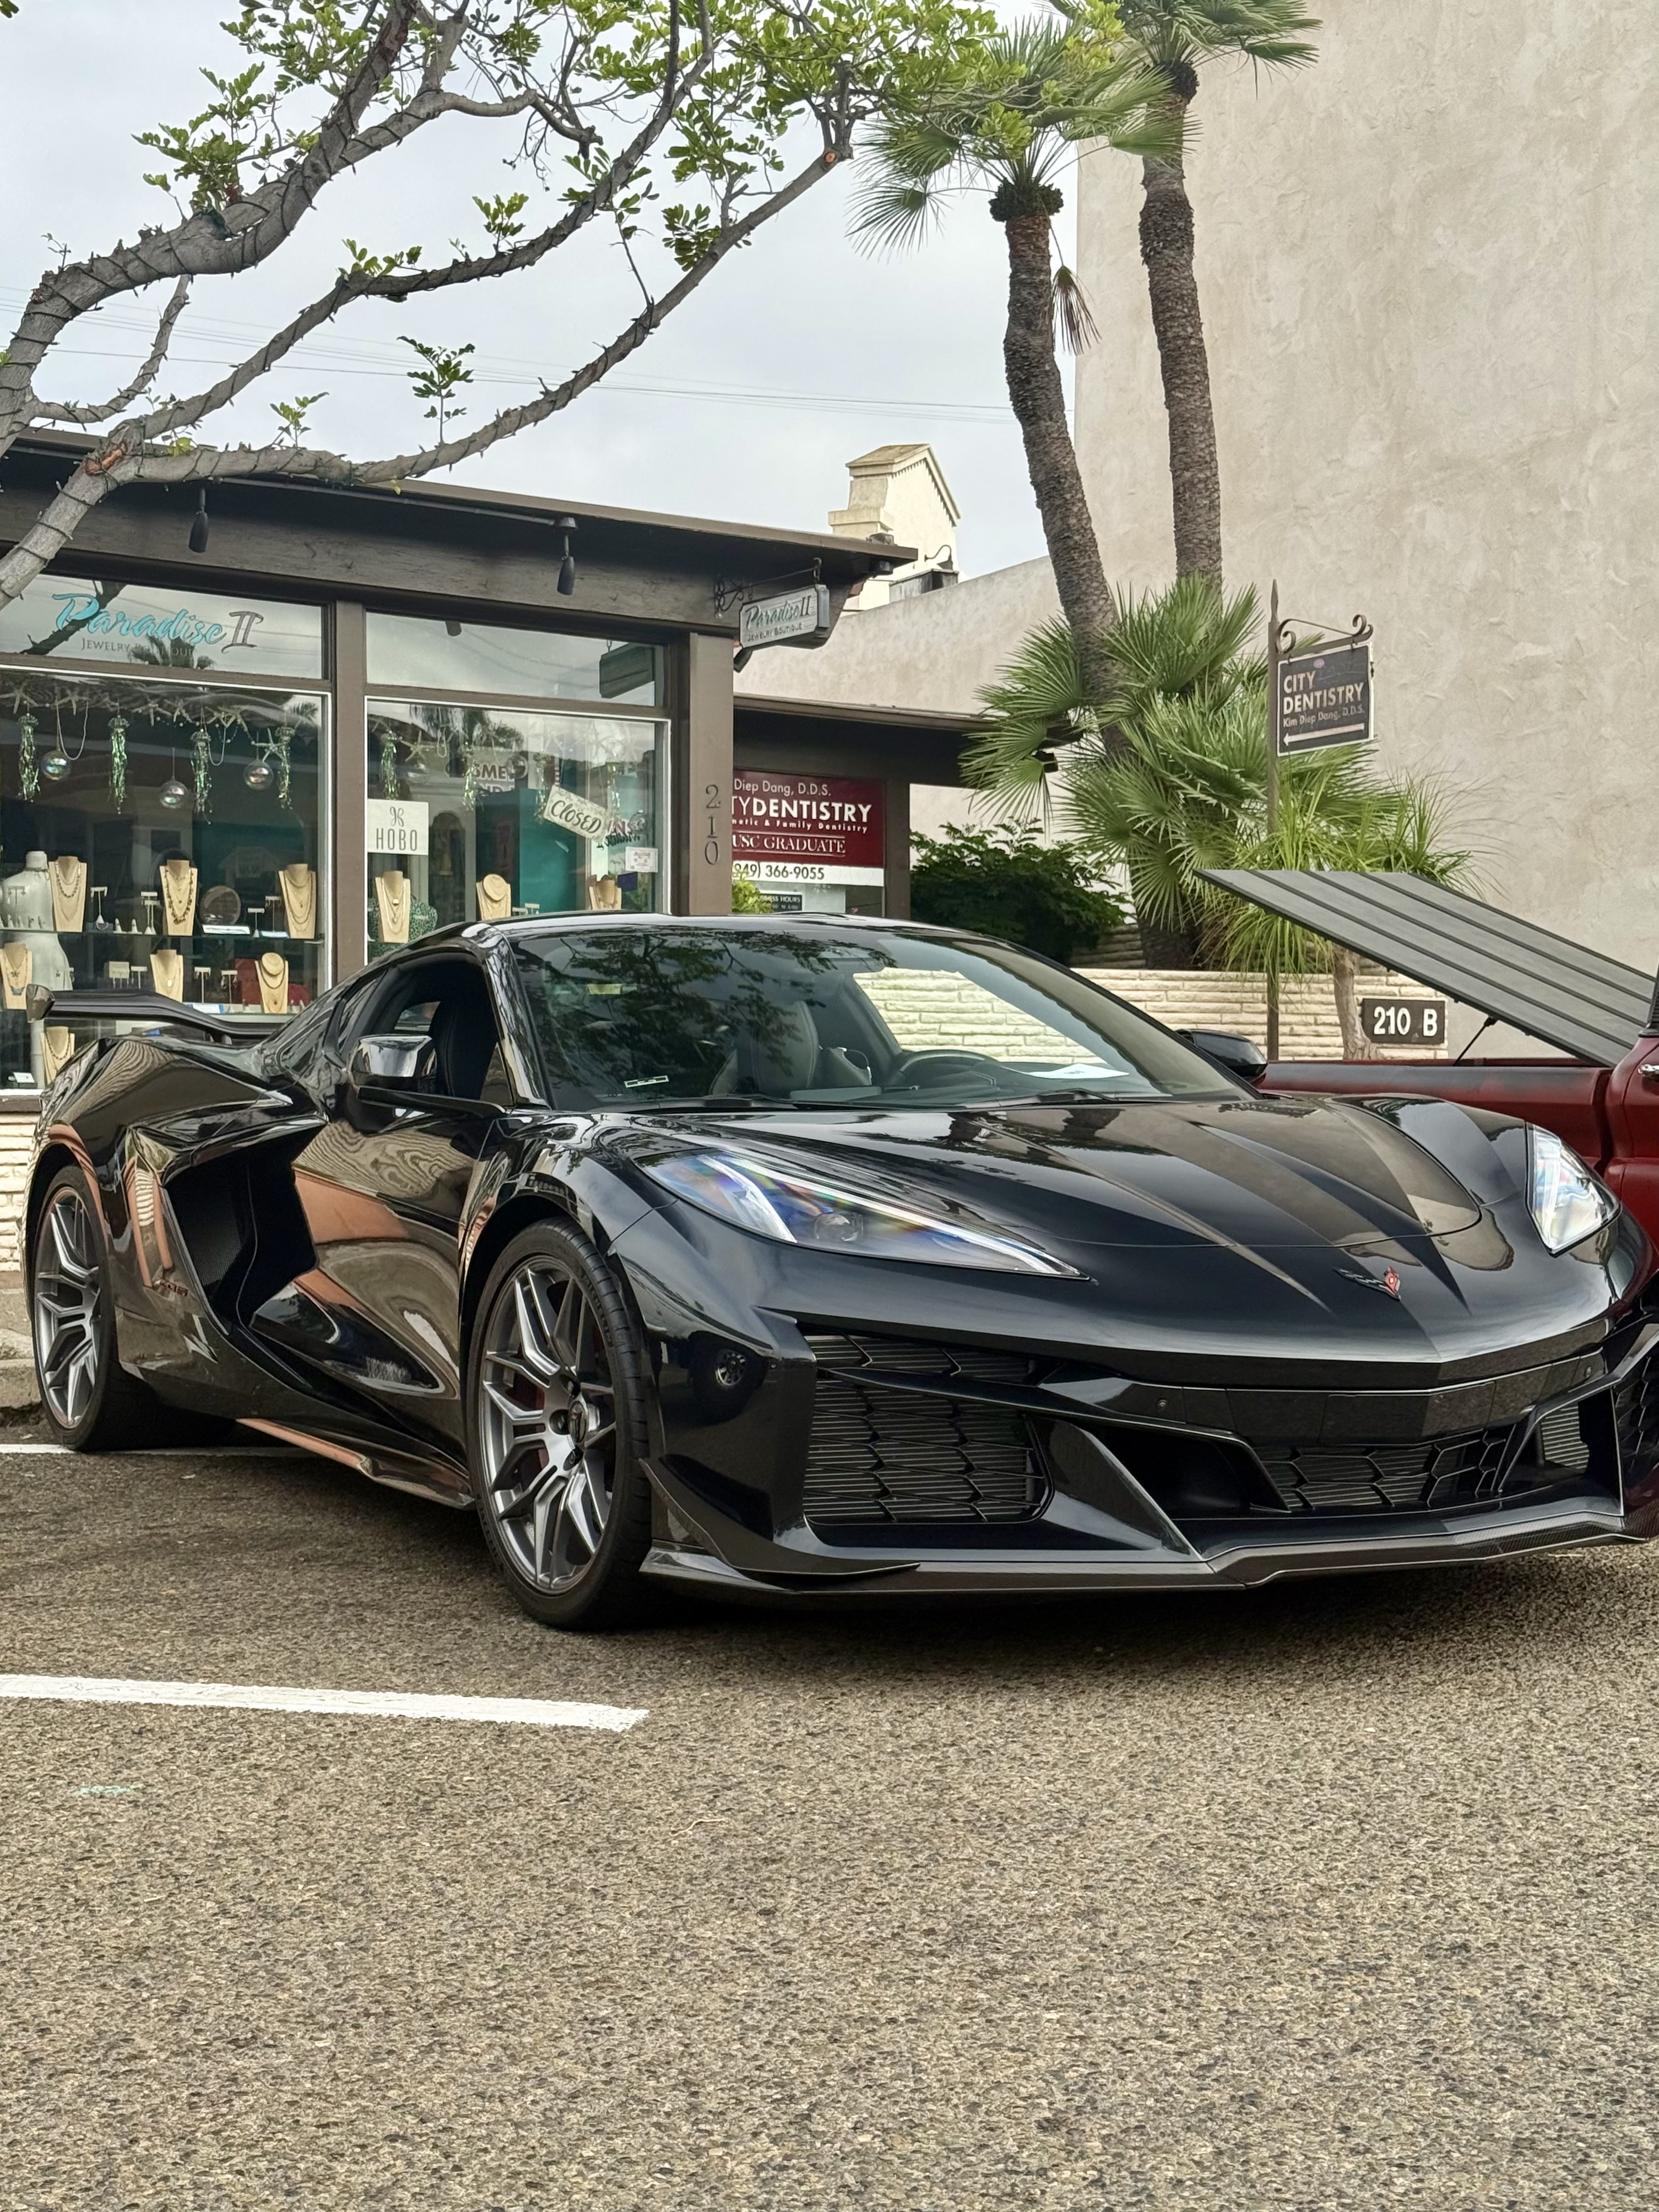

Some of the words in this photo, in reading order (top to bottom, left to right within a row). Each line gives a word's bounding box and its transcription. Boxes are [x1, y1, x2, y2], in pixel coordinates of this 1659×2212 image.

[52, 593, 226, 644] Paradise
[221, 610, 264, 654] II
[745, 600, 799, 630] Paradise
[799, 595, 812, 617] II
[747, 629, 773, 642] JEWELRY
[774, 622, 803, 636] BOUTIQUE
[81, 637, 130, 652] JEWELRY
[1283, 670, 1316, 694] CITY
[1283, 682, 1364, 715] DENTISTRY
[1283, 717, 1298, 728] Kim
[1299, 714, 1316, 728] Diep
[1318, 711, 1341, 721] Dang,
[734, 778, 759, 794] Diep
[762, 780, 794, 796] Dang,
[798, 782, 831, 796] D.D.S.
[704, 784, 721, 865] 210
[776, 820, 811, 831] Family
[818, 822, 868, 834] Dentistry
[376, 827, 418, 852] HOBO
[732, 834, 760, 848] USC
[763, 836, 846, 854] GRADUATE
[765, 864, 825, 880] 366-9055
[1373, 1006, 1411, 1035] 210
[1423, 1008, 1438, 1037] B
